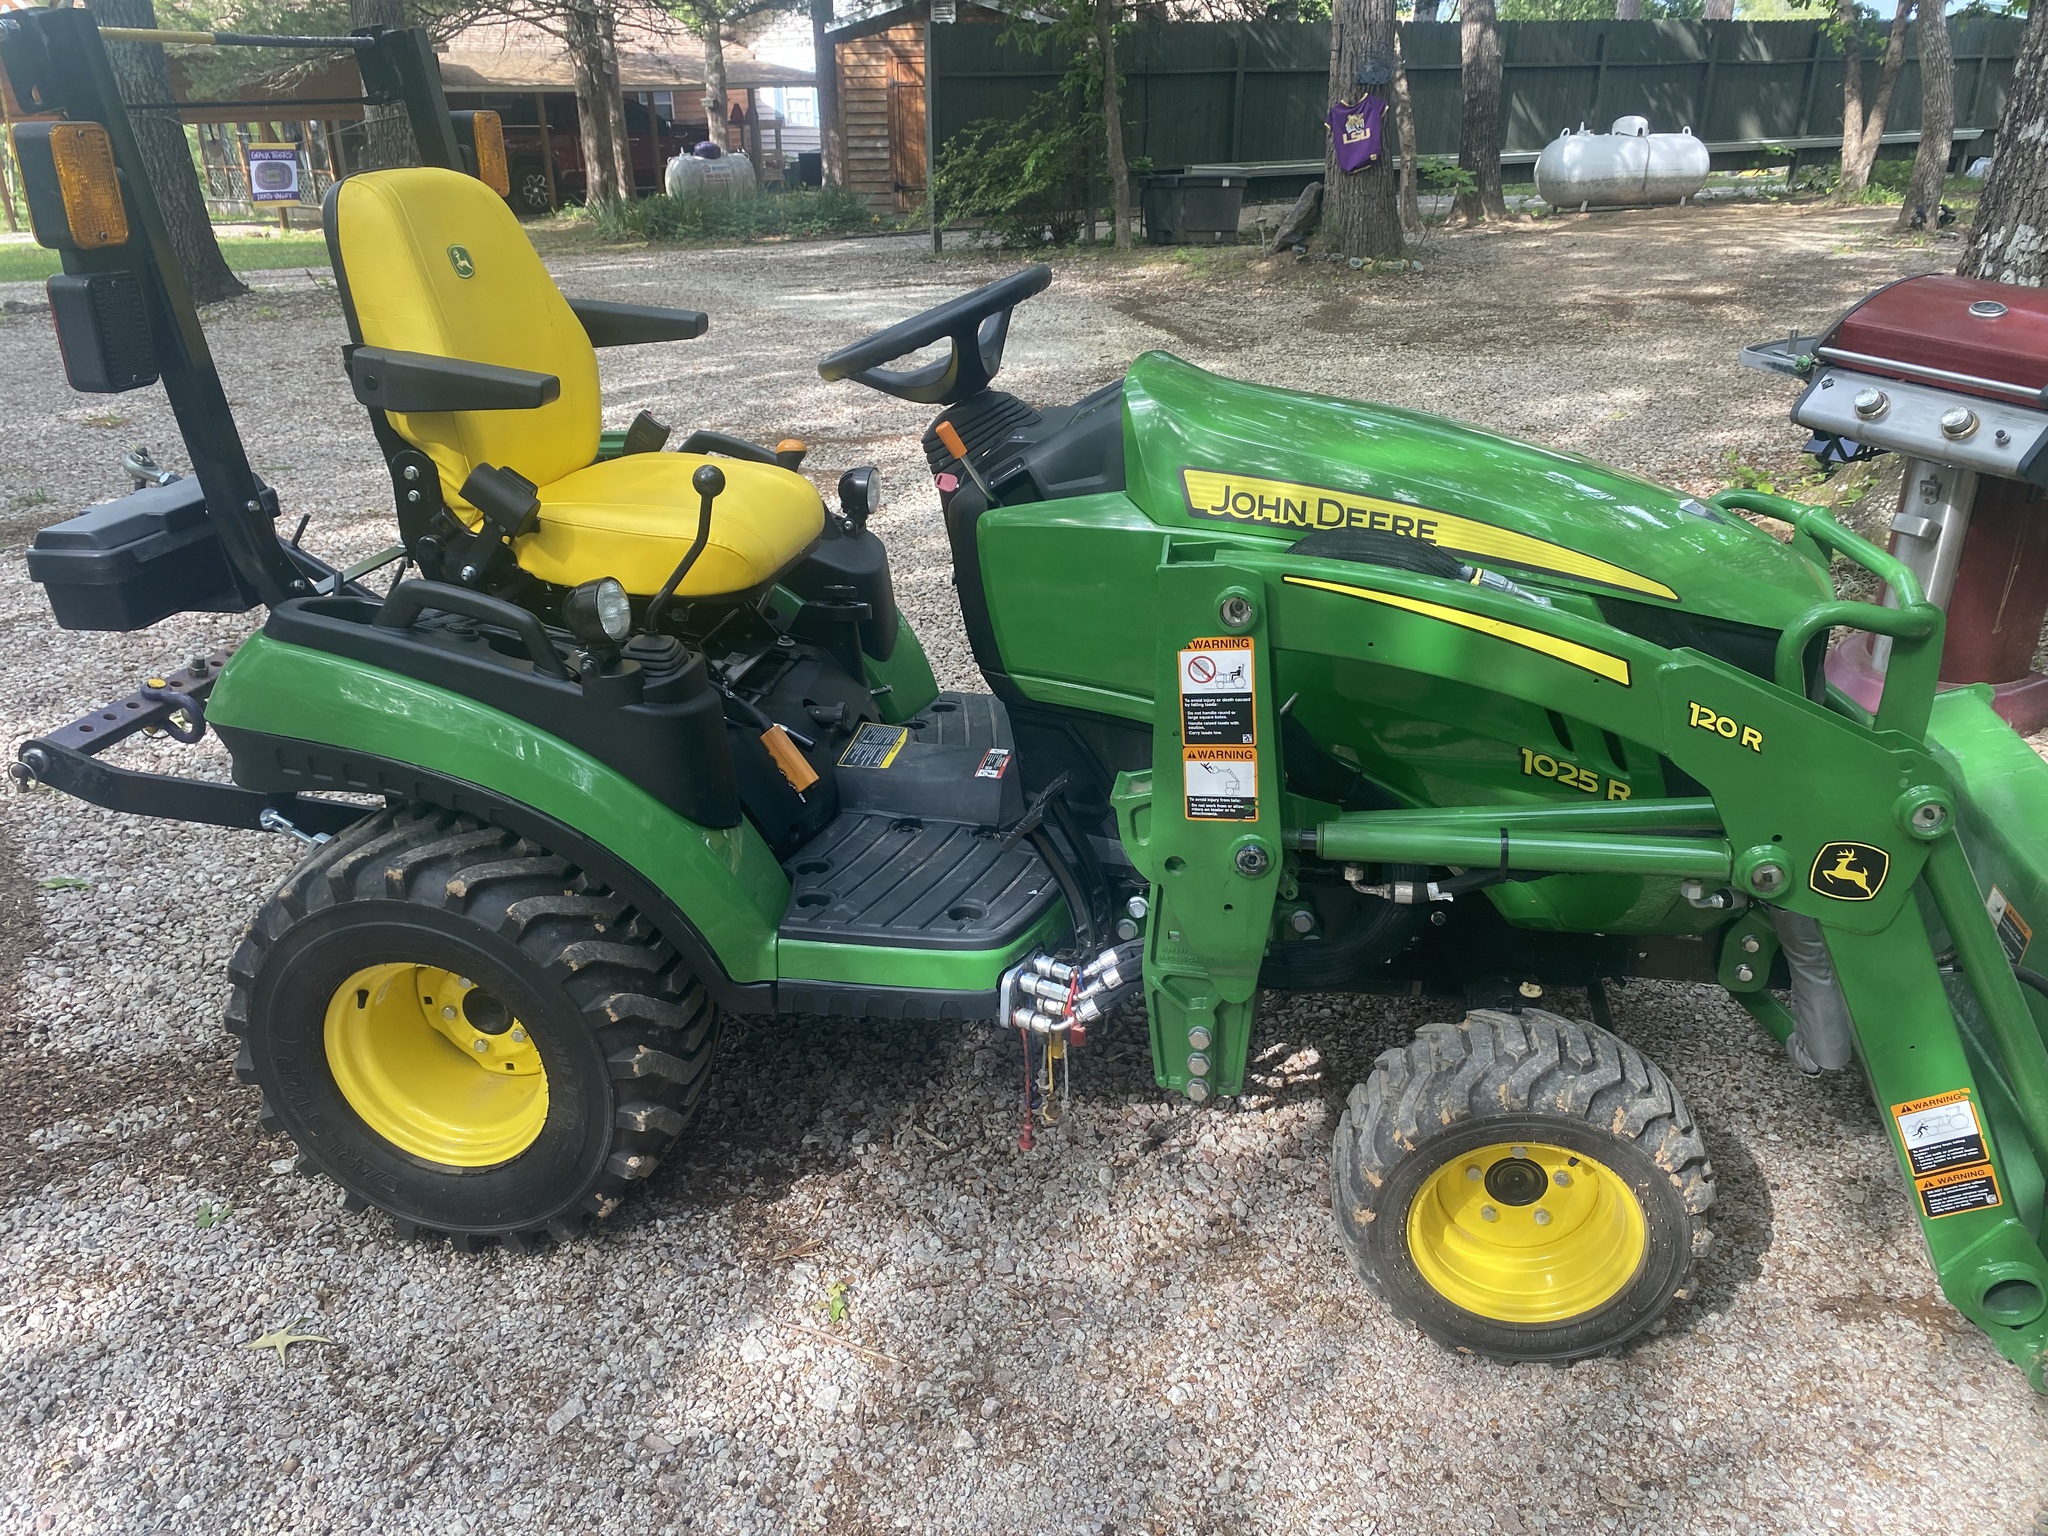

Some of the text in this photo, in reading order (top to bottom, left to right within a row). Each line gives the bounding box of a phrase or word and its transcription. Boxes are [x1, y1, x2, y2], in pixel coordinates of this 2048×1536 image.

[1342, 128, 1370, 144] LSU
[271, 151, 293, 160] TIGERS
[1211, 485, 1438, 544] JOHN DEERE
[1192, 638, 1250, 650] WARNING
[1689, 702, 1762, 752] 120 R
[1198, 750, 1253, 760] WARNING
[1521, 747, 1632, 800] 1025 R
[1912, 1093, 1962, 1110] WARNING
[1936, 1170, 1986, 1184] WARNING
